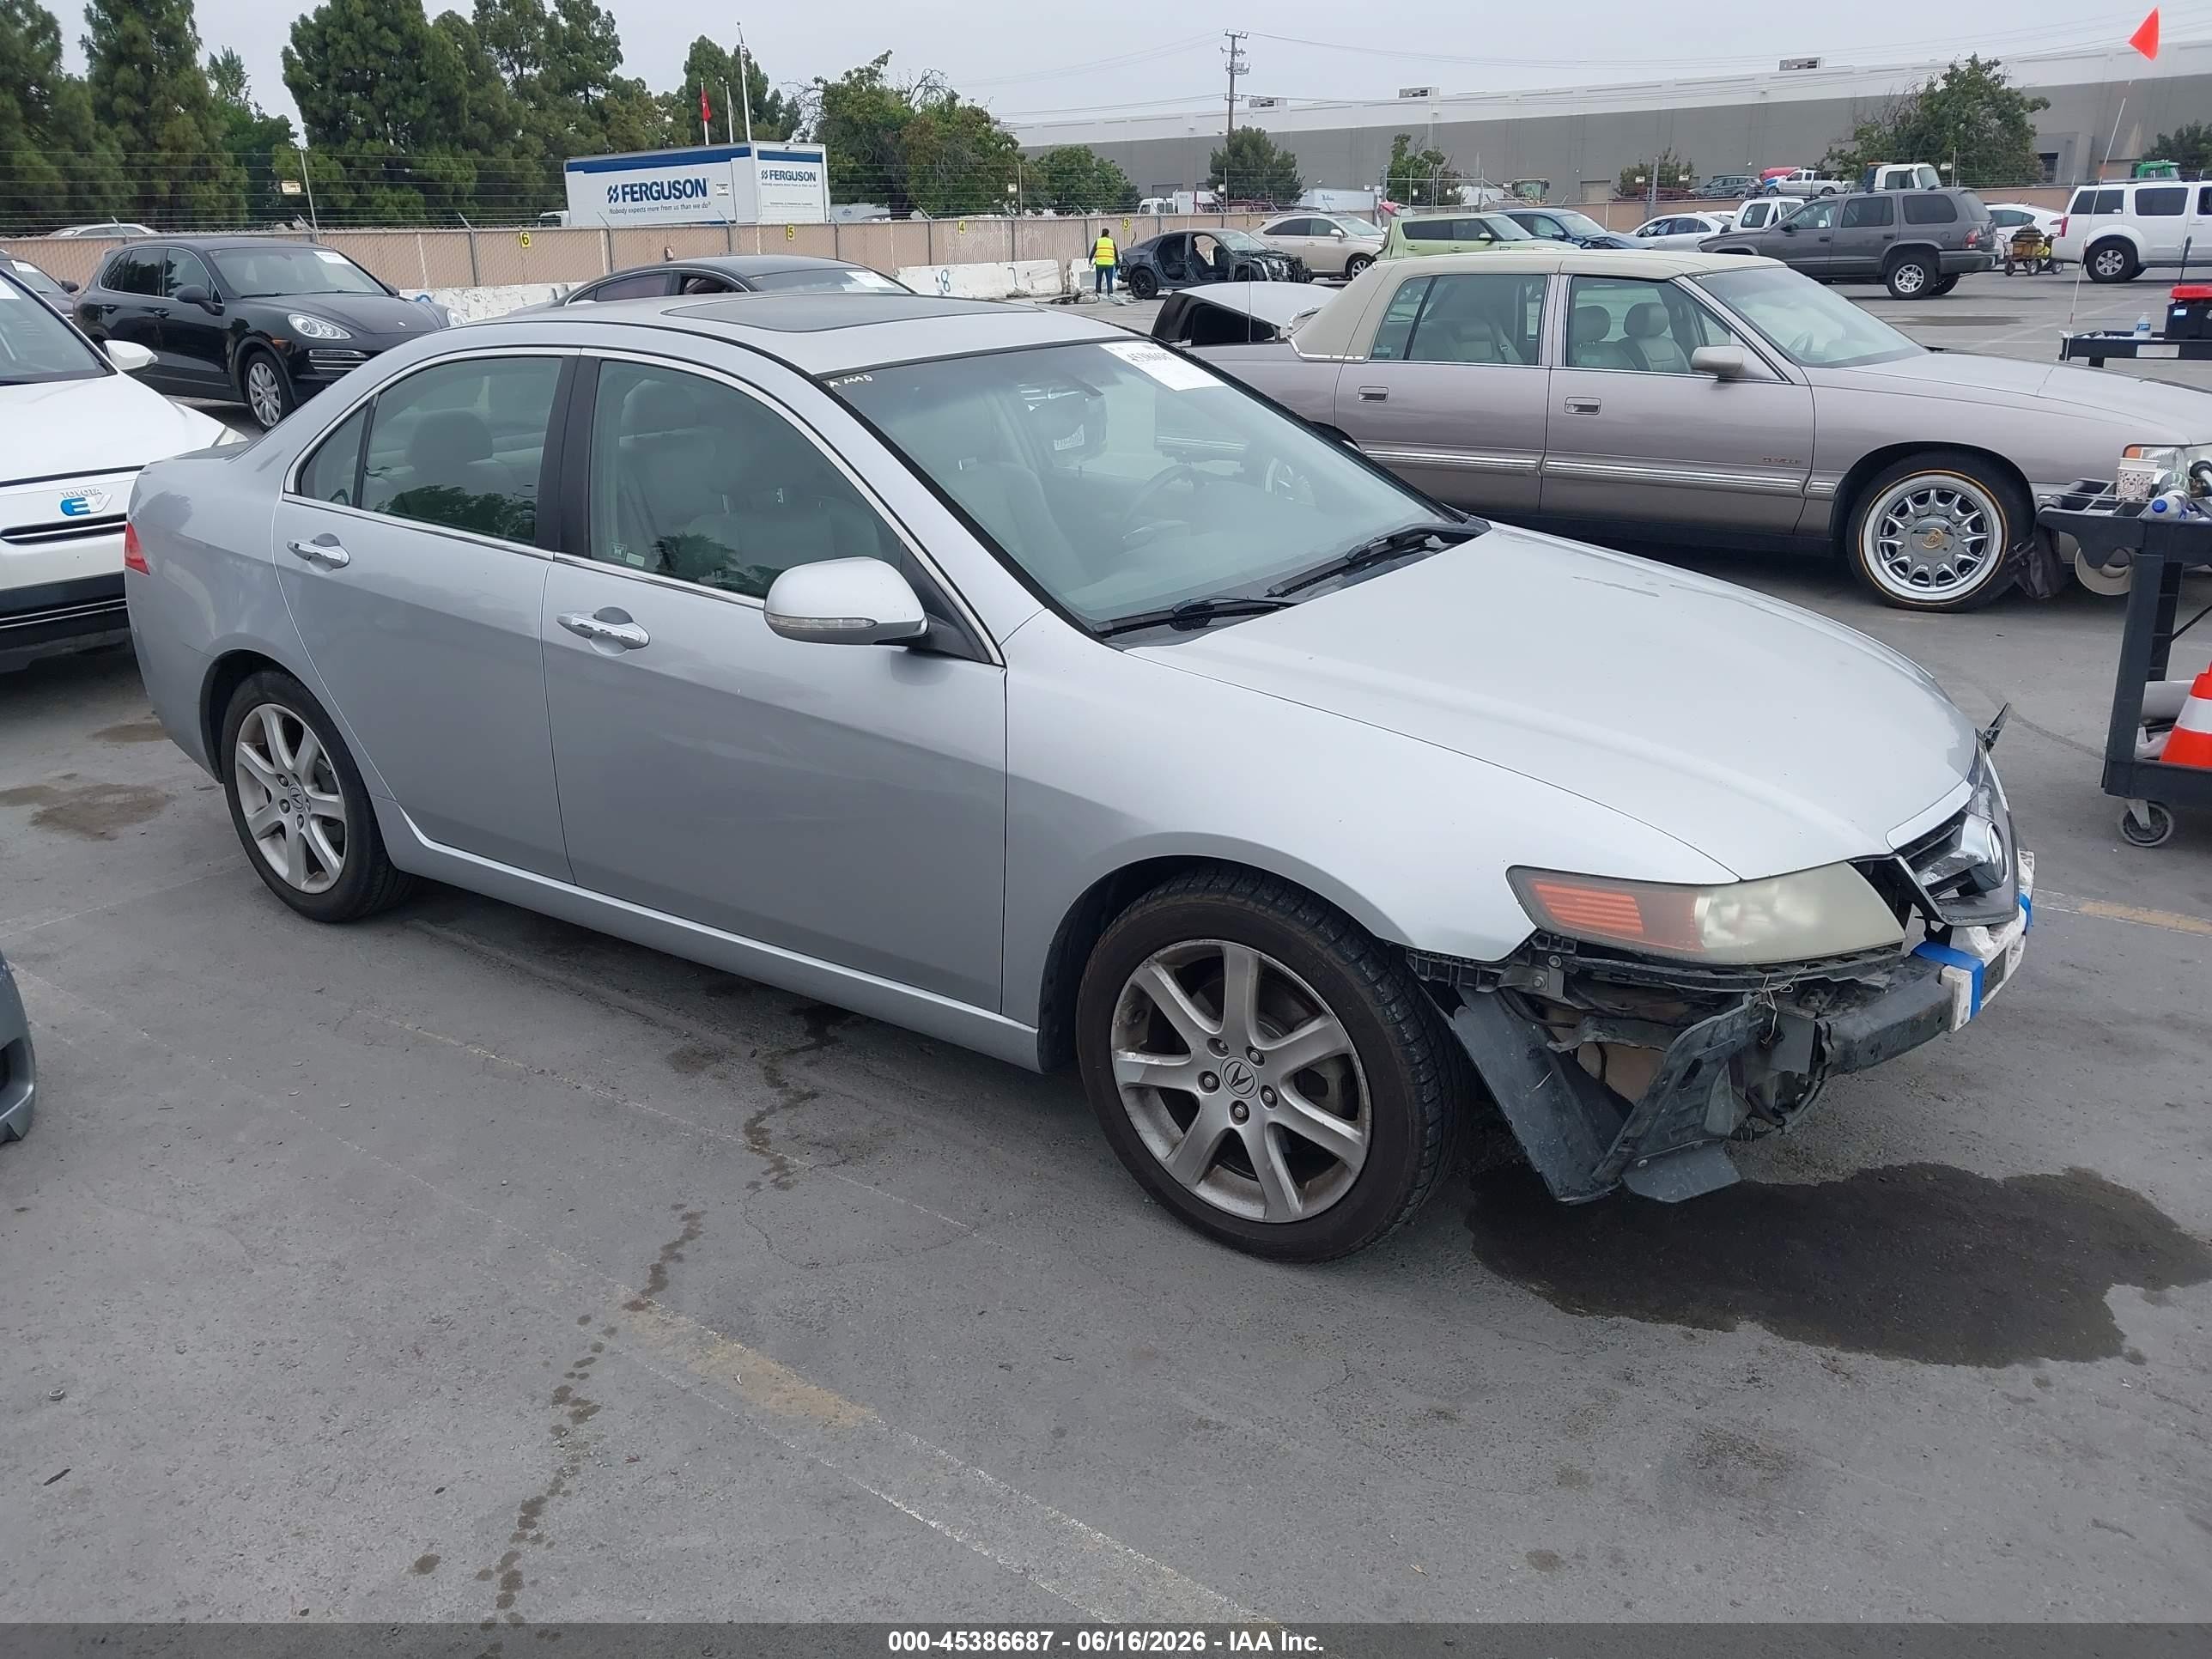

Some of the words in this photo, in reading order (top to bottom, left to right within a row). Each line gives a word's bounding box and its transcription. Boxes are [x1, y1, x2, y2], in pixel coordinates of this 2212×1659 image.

[769, 170, 817, 181] FERGUSON
[621, 177, 708, 203] FERGUSON
[609, 206, 627, 215] Nobody
[521, 232, 529, 246] 6
[940, 269, 951, 293] 8
[59, 487, 103, 498] TOYOTA
